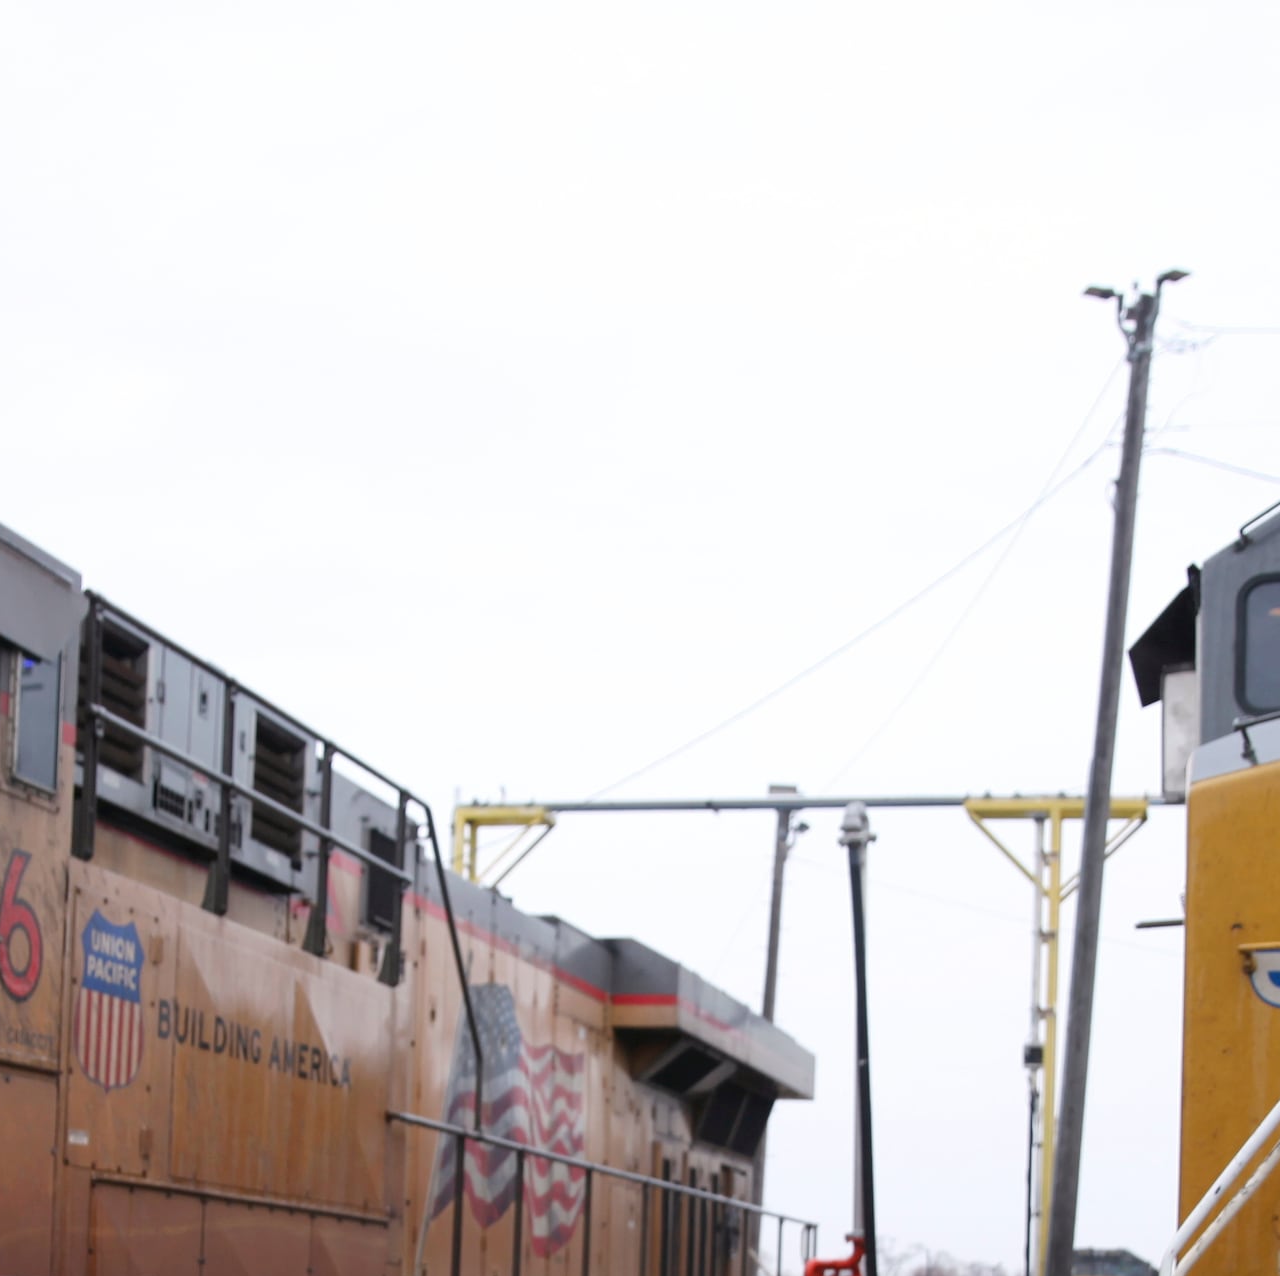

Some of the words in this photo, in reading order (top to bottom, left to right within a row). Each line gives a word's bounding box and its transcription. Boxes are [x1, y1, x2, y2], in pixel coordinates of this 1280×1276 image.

[91, 928, 136, 965] UNION
[87, 954, 137, 992] PACIFIC
[157, 998, 262, 1064] BUILDING
[268, 1036, 352, 1088] AMERICA
